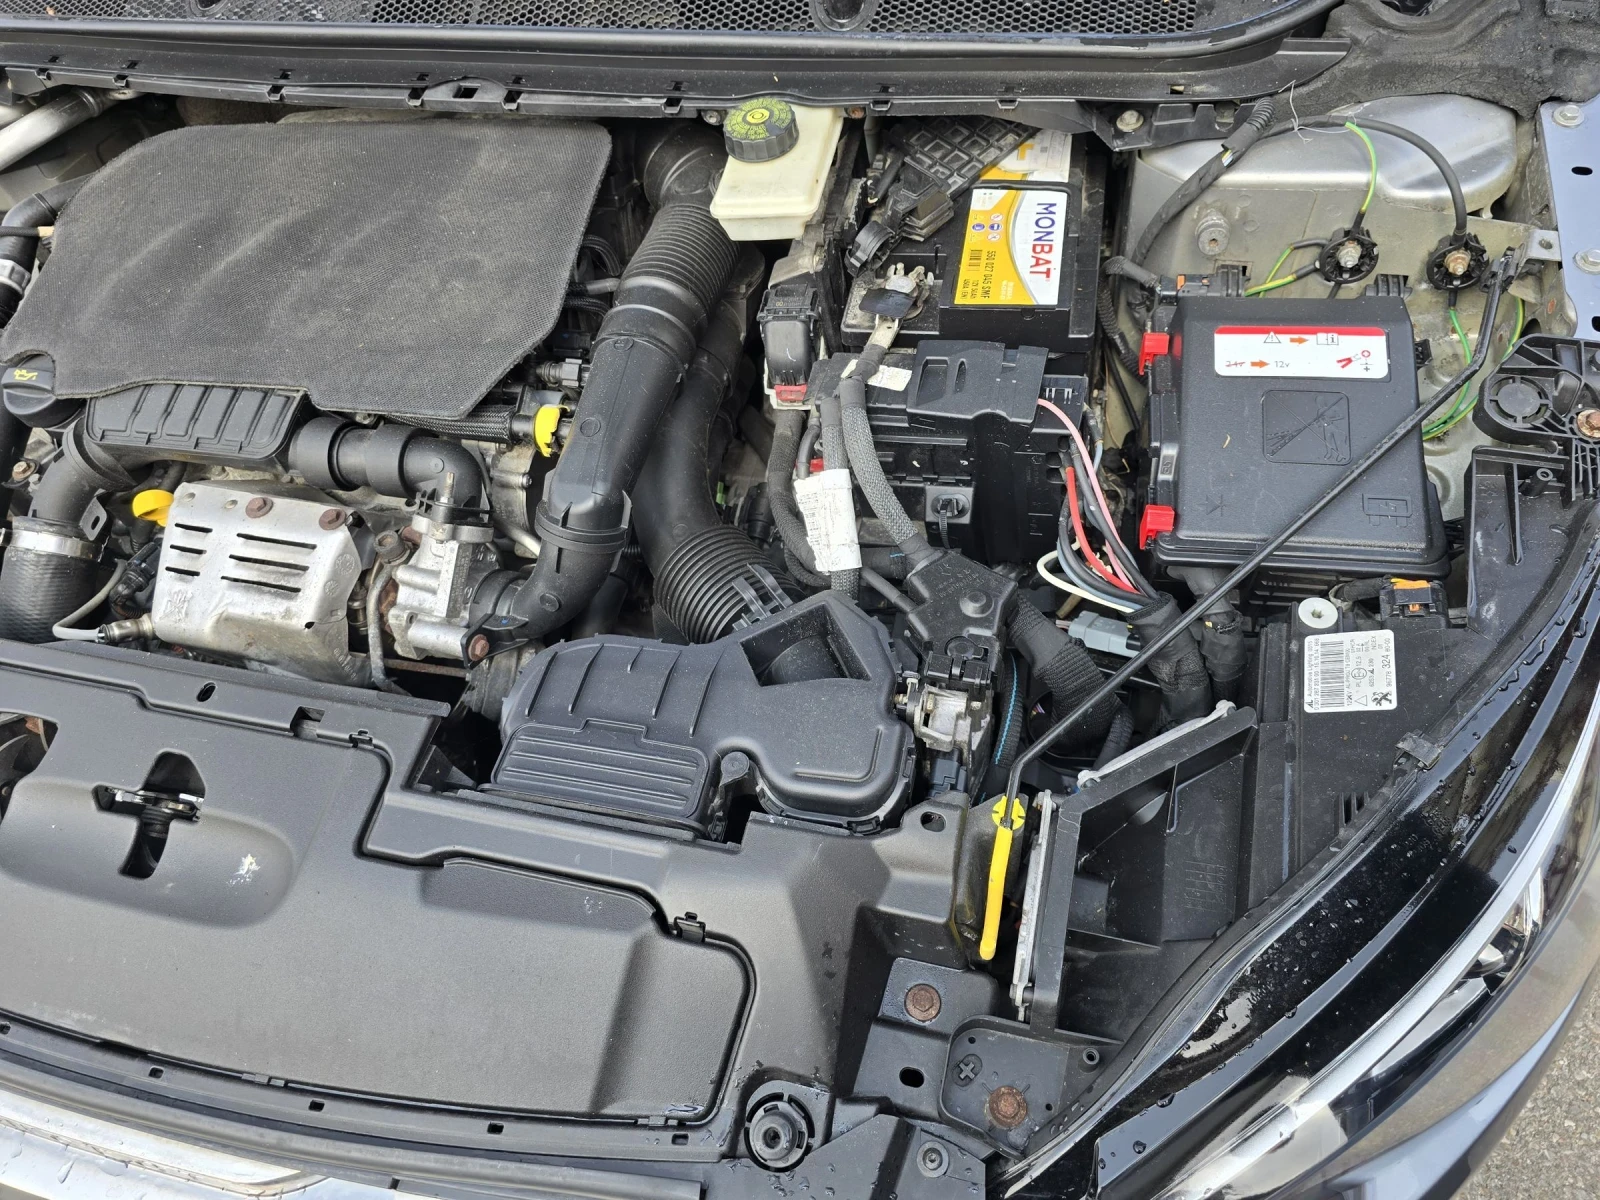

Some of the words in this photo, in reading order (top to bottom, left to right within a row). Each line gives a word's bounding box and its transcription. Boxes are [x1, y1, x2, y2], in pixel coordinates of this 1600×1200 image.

[1030, 203, 1057, 278] MONBAT
[986, 251, 996, 260] 550
[985, 262, 994, 272] 027
[983, 274, 992, 284] 045
[980, 286, 991, 299] SMF
[1275, 360, 1290, 368] 12v
[1382, 655, 1390, 669] 324
